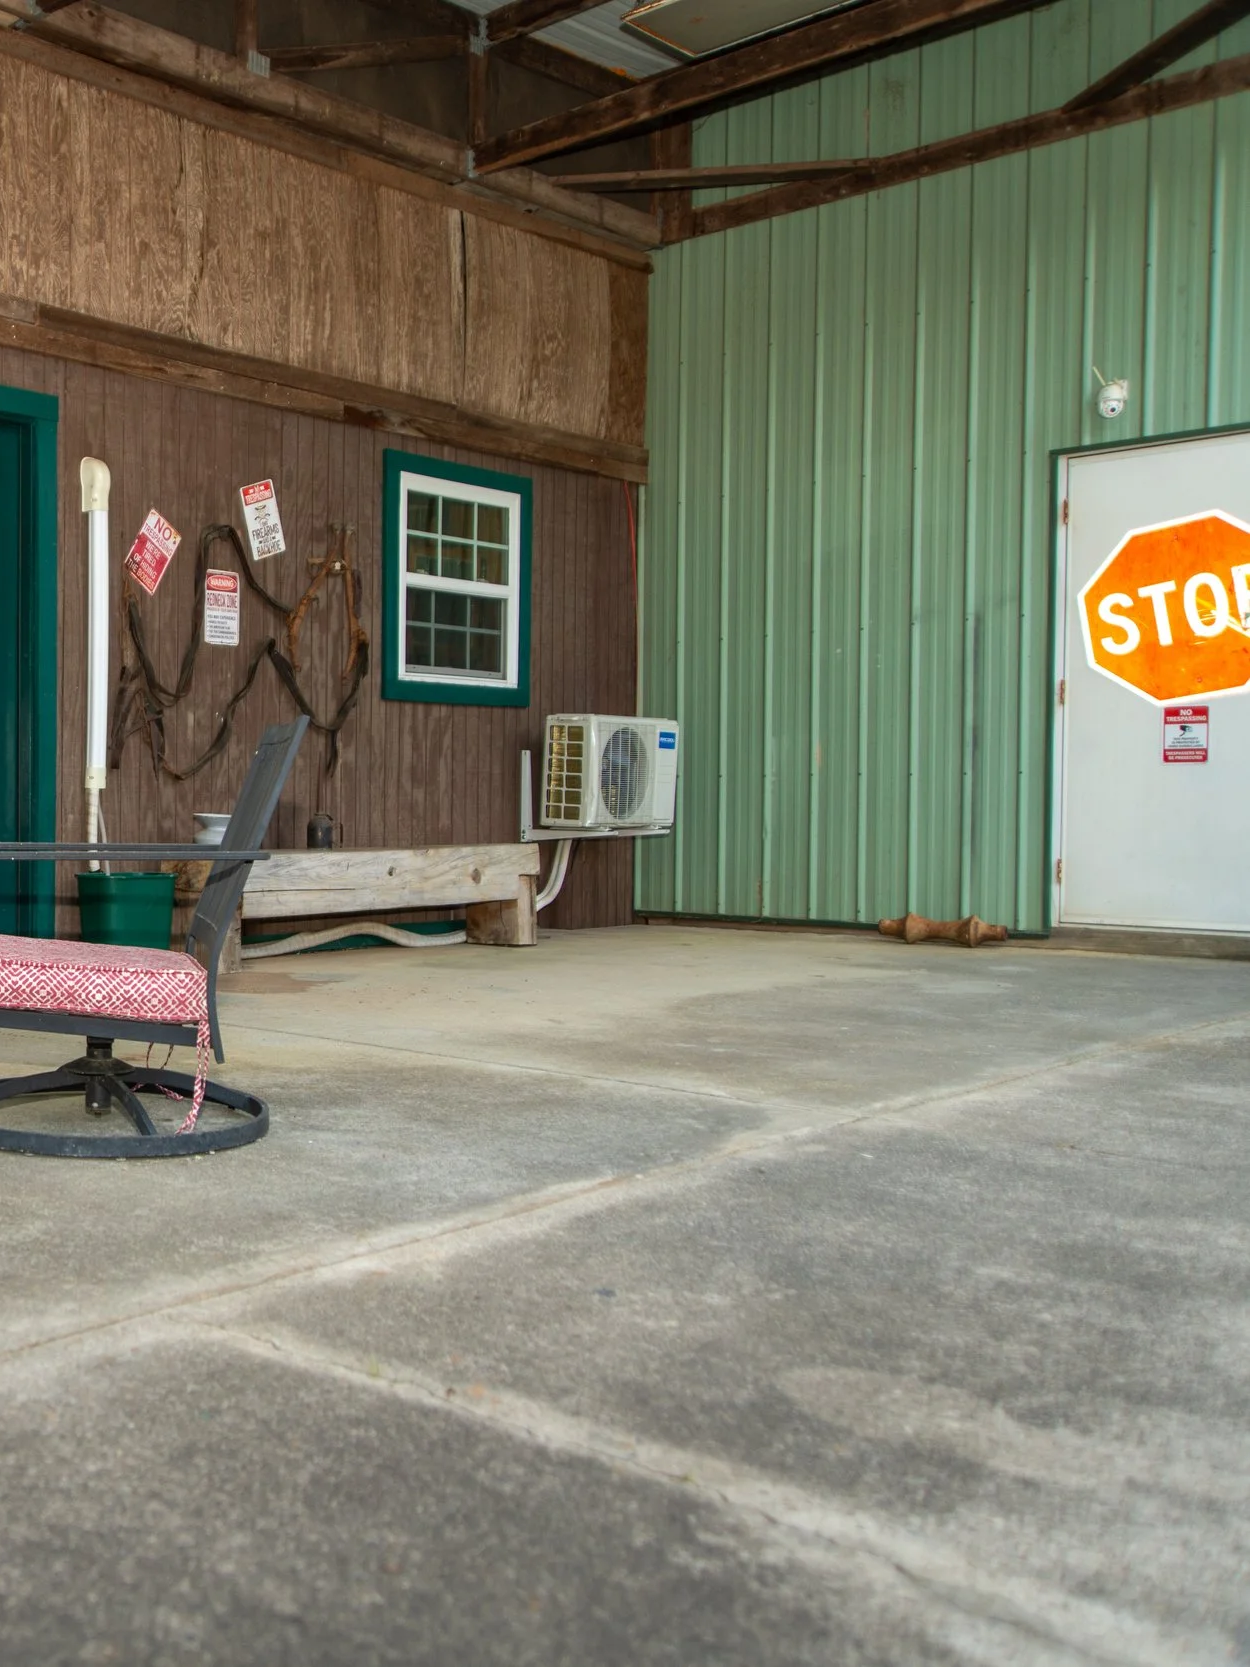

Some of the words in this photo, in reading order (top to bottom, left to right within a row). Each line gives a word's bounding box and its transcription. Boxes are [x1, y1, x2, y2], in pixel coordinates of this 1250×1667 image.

[144, 523, 173, 556] TRESPASSING
[154, 518, 172, 541] NO
[252, 523, 280, 540] FIREARMS
[127, 559, 138, 573] THE
